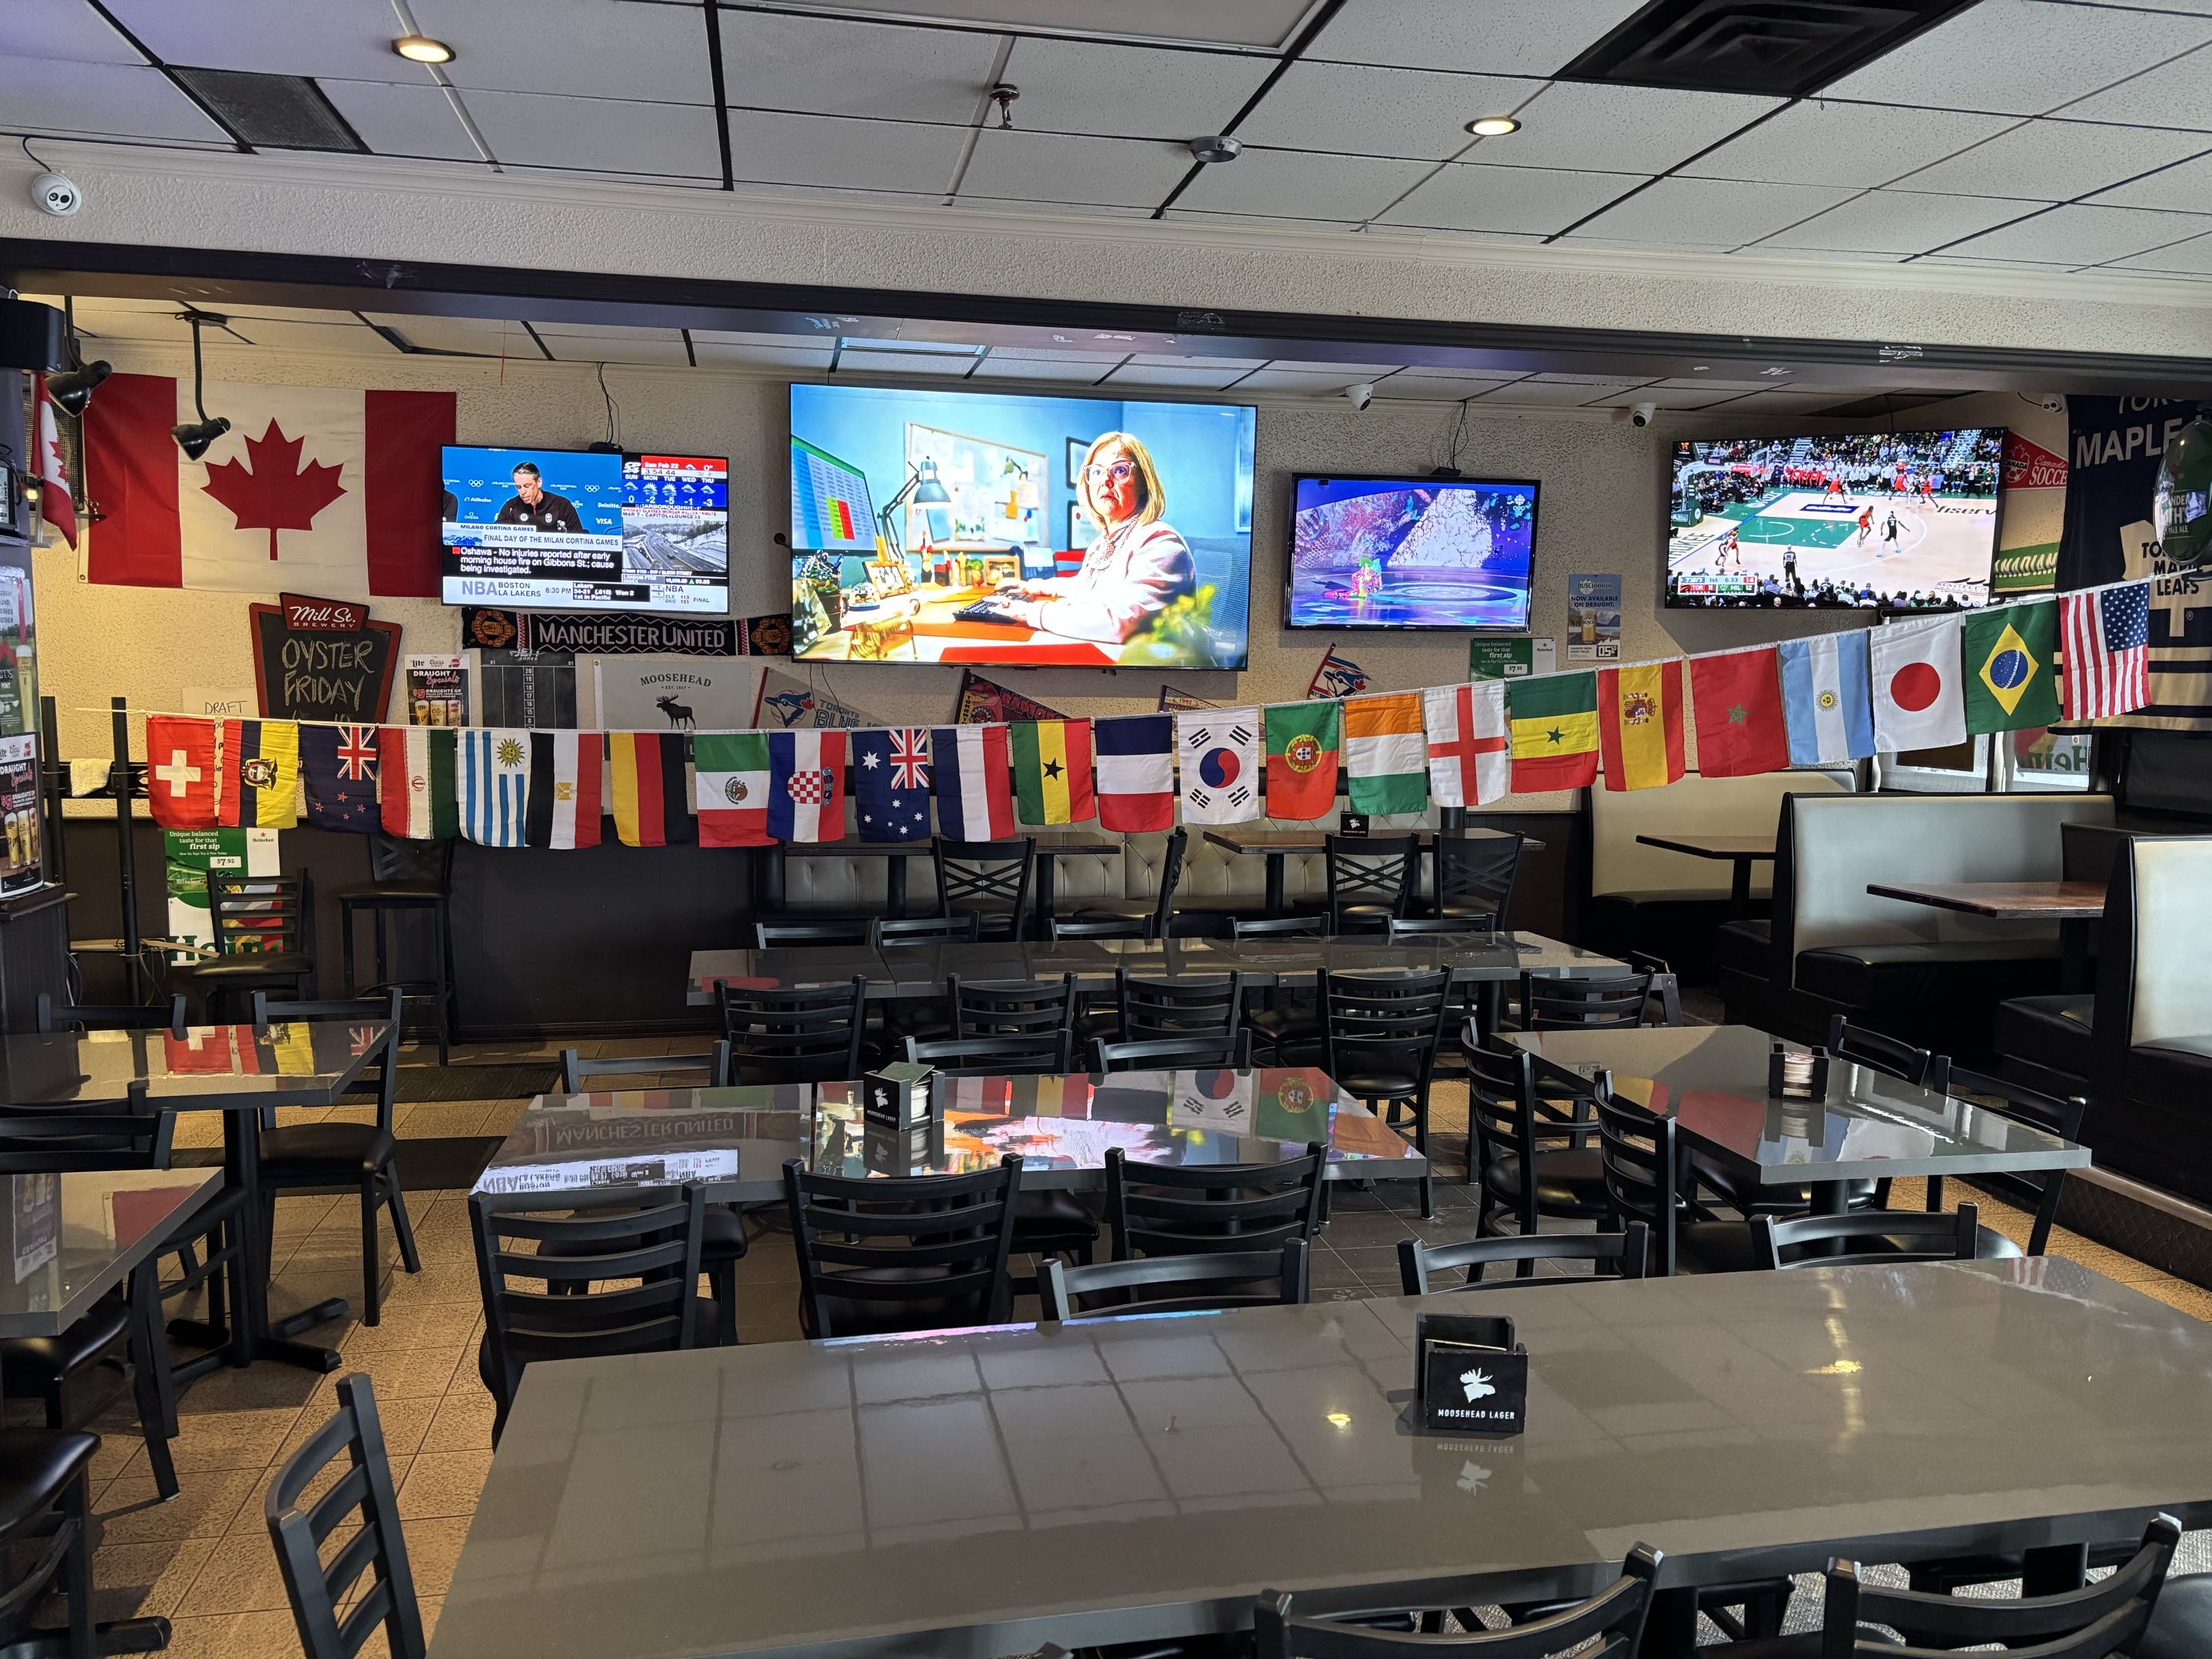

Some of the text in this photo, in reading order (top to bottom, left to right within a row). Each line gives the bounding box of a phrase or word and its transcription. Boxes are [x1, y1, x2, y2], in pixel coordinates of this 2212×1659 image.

[2034, 455, 2066, 469] Canada
[2028, 465, 2068, 485] SOCCE
[1936, 505, 1997, 515] fiserv
[460, 547, 492, 555] Oshawa
[540, 551, 571, 560] reported
[573, 551, 591, 559] after
[591, 552, 611, 561] early
[460, 557, 492, 566] morning
[493, 556, 517, 565] house
[518, 557, 531, 565] fire
[543, 558, 575, 567] Gibbons
[460, 565, 531, 575] being investigated.
[462, 581, 497, 595] NBA
[2157, 578, 2200, 596] LEAFS
[289, 606, 356, 623] Mill St.
[539, 621, 659, 647] MANCHESTER
[662, 627, 725, 648] UNITED
[281, 638, 375, 674] OYSTER
[426, 671, 460, 689] Specials
[640, 673, 711, 687] MOOSEHEAD
[284, 670, 366, 712] FRIDAY
[412, 688, 426, 699] $5
[204, 700, 248, 714] DRAFT
[819, 699, 860, 718] TORONTO
[1000, 687, 1063, 720] RAPTOR
[813, 710, 860, 728] BLUE
[0, 763, 27, 775] DRAUGHT
[217, 858, 235, 866] $7.95
[1438, 1409, 1515, 1420] MOOSEHEAD LAGER
